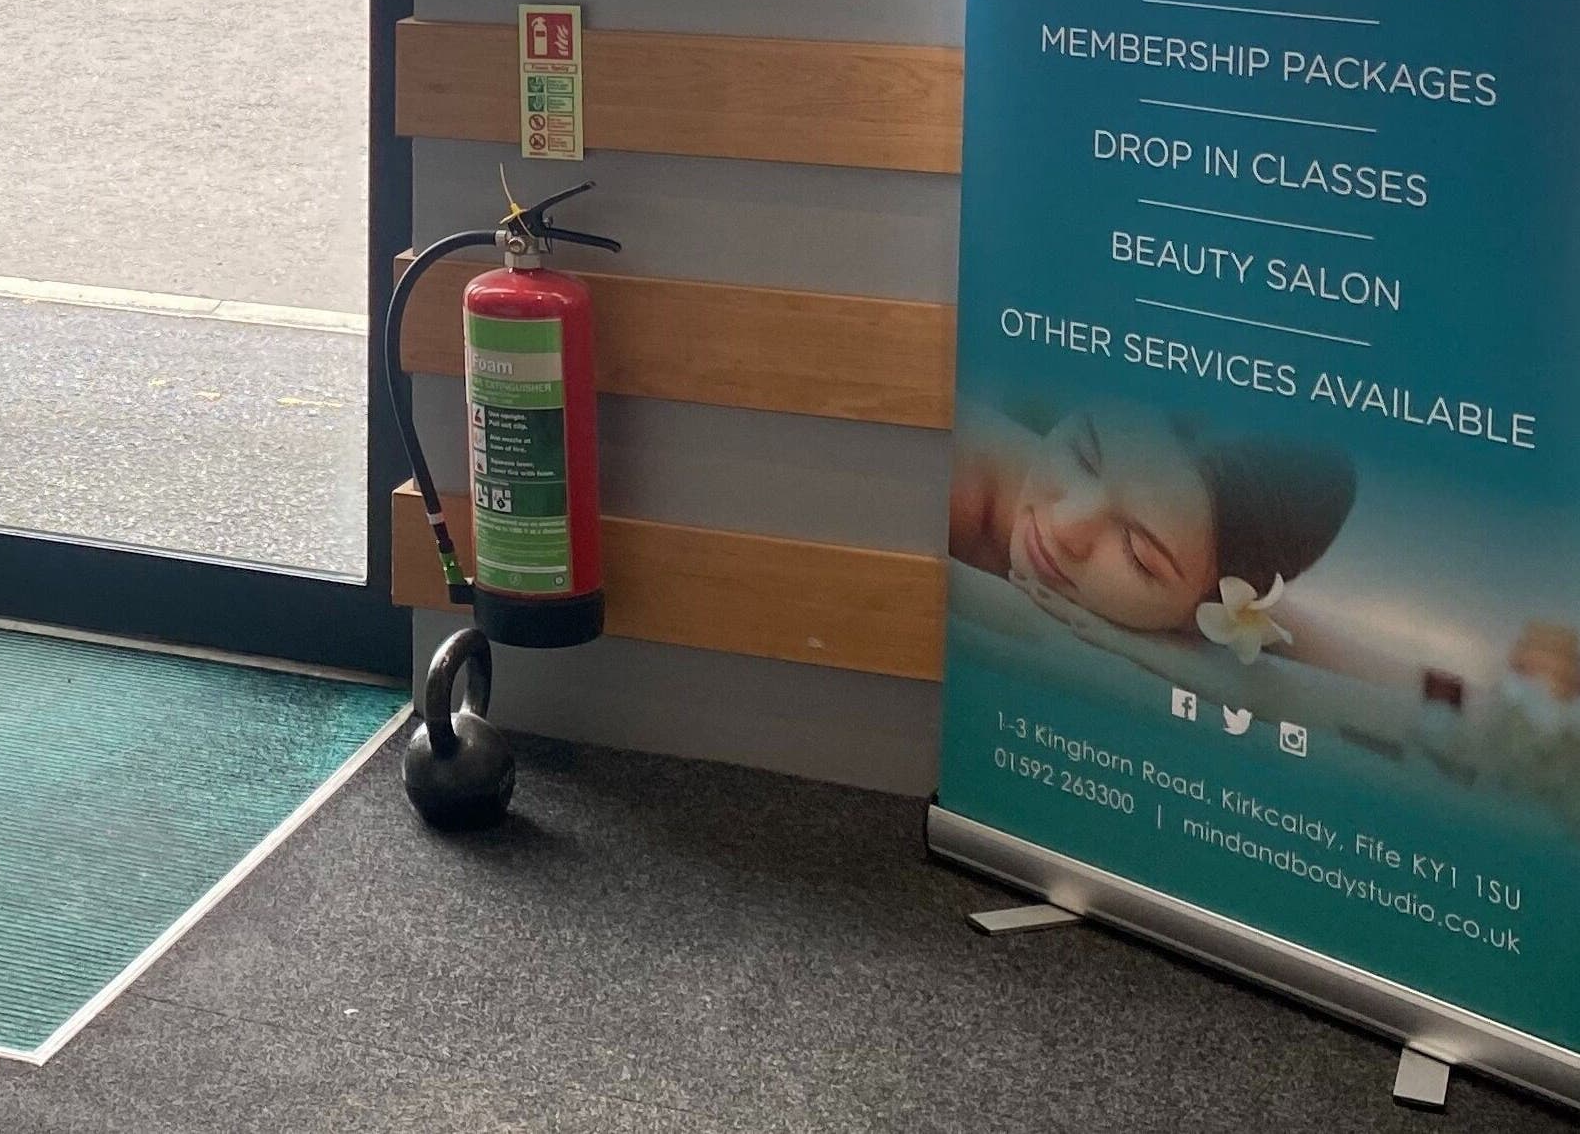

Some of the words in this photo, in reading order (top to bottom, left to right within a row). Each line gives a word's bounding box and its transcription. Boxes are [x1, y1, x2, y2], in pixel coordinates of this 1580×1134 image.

[1041, 24, 1270, 77] MEMBERSHIP
[1283, 51, 1498, 107] PACKAGES
[1094, 130, 1193, 169] DROP
[1205, 146, 1238, 178] IN
[1252, 153, 1429, 208] CLASSES
[1112, 231, 1254, 284] BEAUTY
[1266, 259, 1401, 312] SALON
[473, 353, 513, 375] Foam
[1001, 308, 1112, 358] OTHER
[1123, 333, 1298, 397] SERVICES
[1310, 372, 1537, 449] AVAILABLE
[994, 748, 1055, 787] 01592
[1060, 771, 1134, 814] 263300
[1183, 818, 1520, 954] mindandbodystudio.co.uk
[998, 711, 1027, 739] 1-3
[1035, 724, 1133, 776] Kinghorn
[1221, 787, 1343, 851] Kirkcaldy,
[1356, 834, 1401, 868] Fife
[1413, 853, 1457, 889] KY1
[1476, 874, 1520, 910] 1SU
